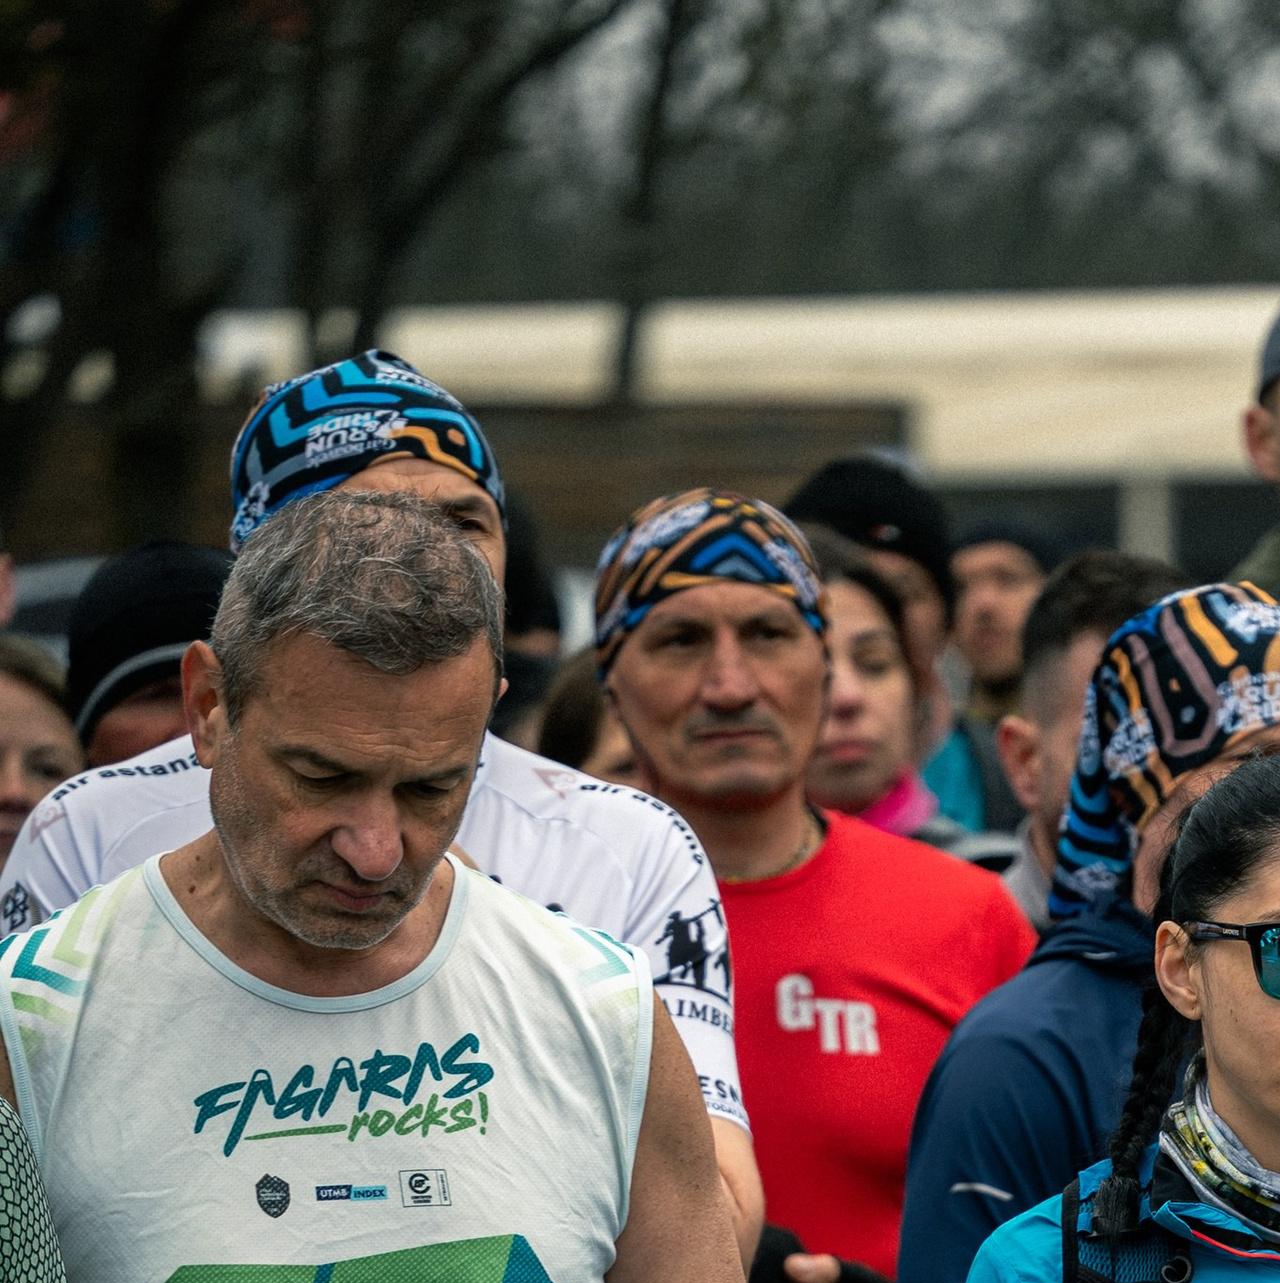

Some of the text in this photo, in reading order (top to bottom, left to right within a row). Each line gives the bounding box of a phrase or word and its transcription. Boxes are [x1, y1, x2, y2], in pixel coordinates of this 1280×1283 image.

[51, 775, 89, 801] air
[774, 971, 882, 1056] GTR
[347, 1091, 490, 1142] rocks!
[353, 1188, 386, 1199] INDEX
